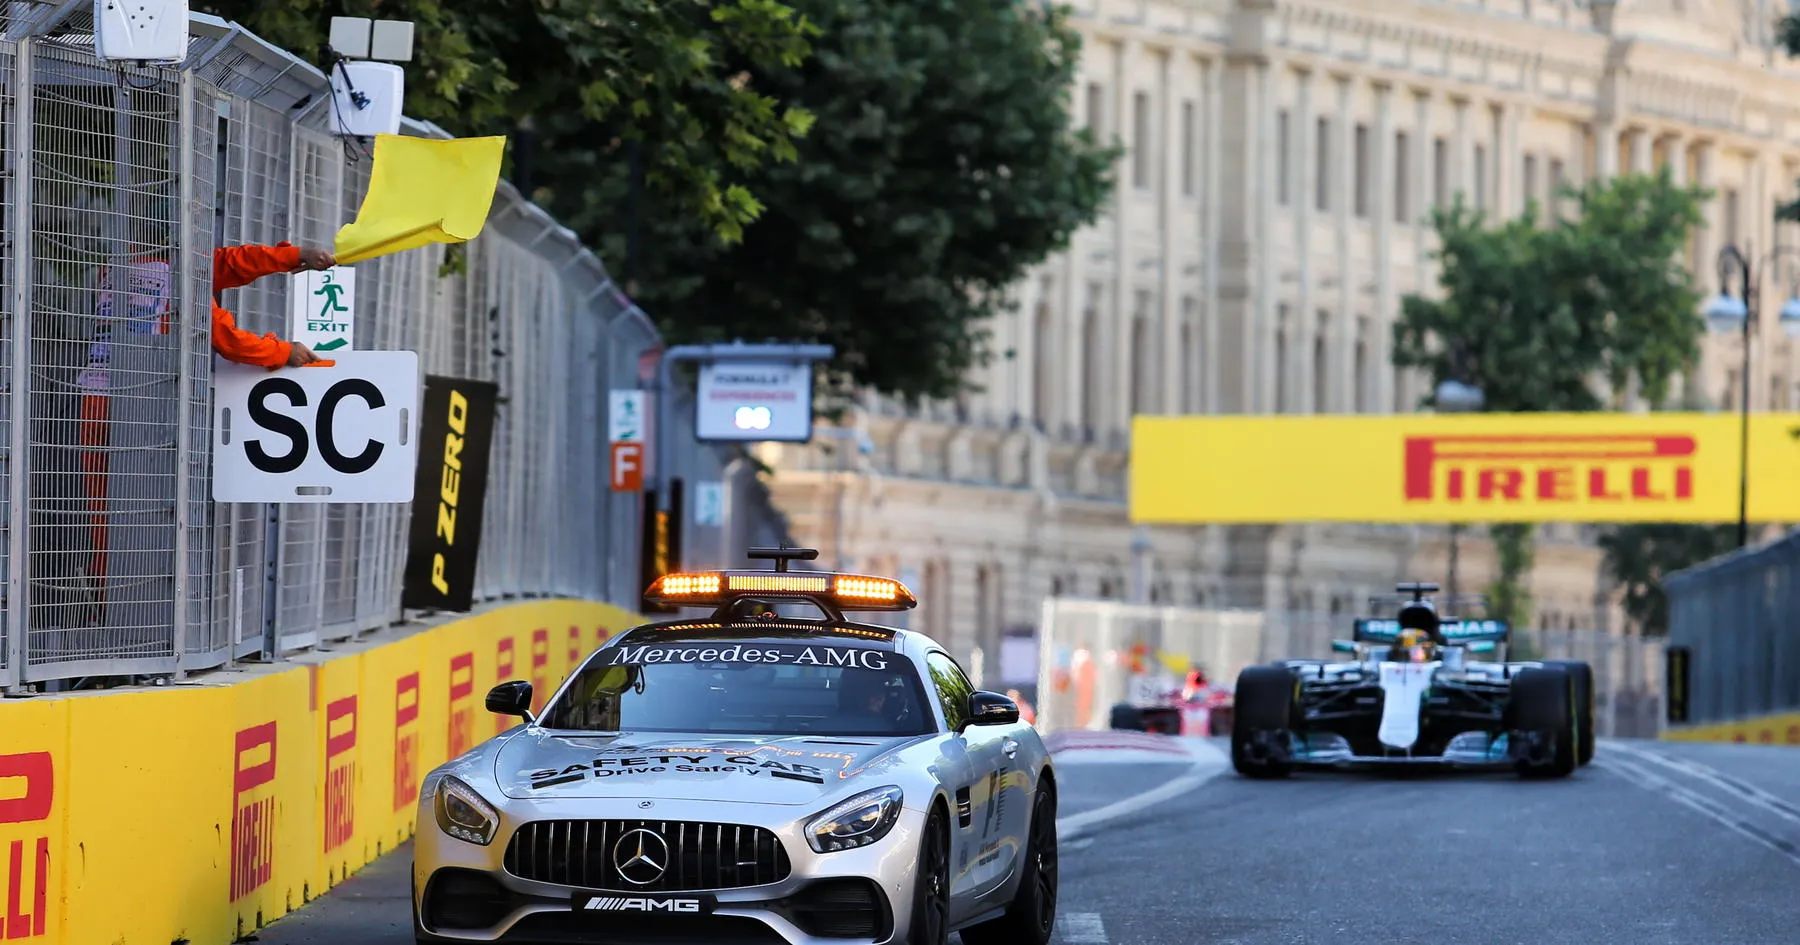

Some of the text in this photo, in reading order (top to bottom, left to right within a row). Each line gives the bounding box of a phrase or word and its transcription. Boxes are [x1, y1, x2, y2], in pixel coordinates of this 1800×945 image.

[307, 322, 349, 332] EXIT
[243, 377, 386, 474] SC
[614, 446, 639, 487] F
[1404, 434, 1697, 501] PIRELLI
[431, 389, 468, 596] P ZERO
[1366, 621, 1498, 635] PENAS
[608, 645, 888, 670] Mercedes-AMG
[530, 755, 822, 781] SAFETY CAR
[594, 764, 760, 778] Drive Safely
[229, 720, 278, 904] PIRELLI
[619, 897, 700, 912] AMG
